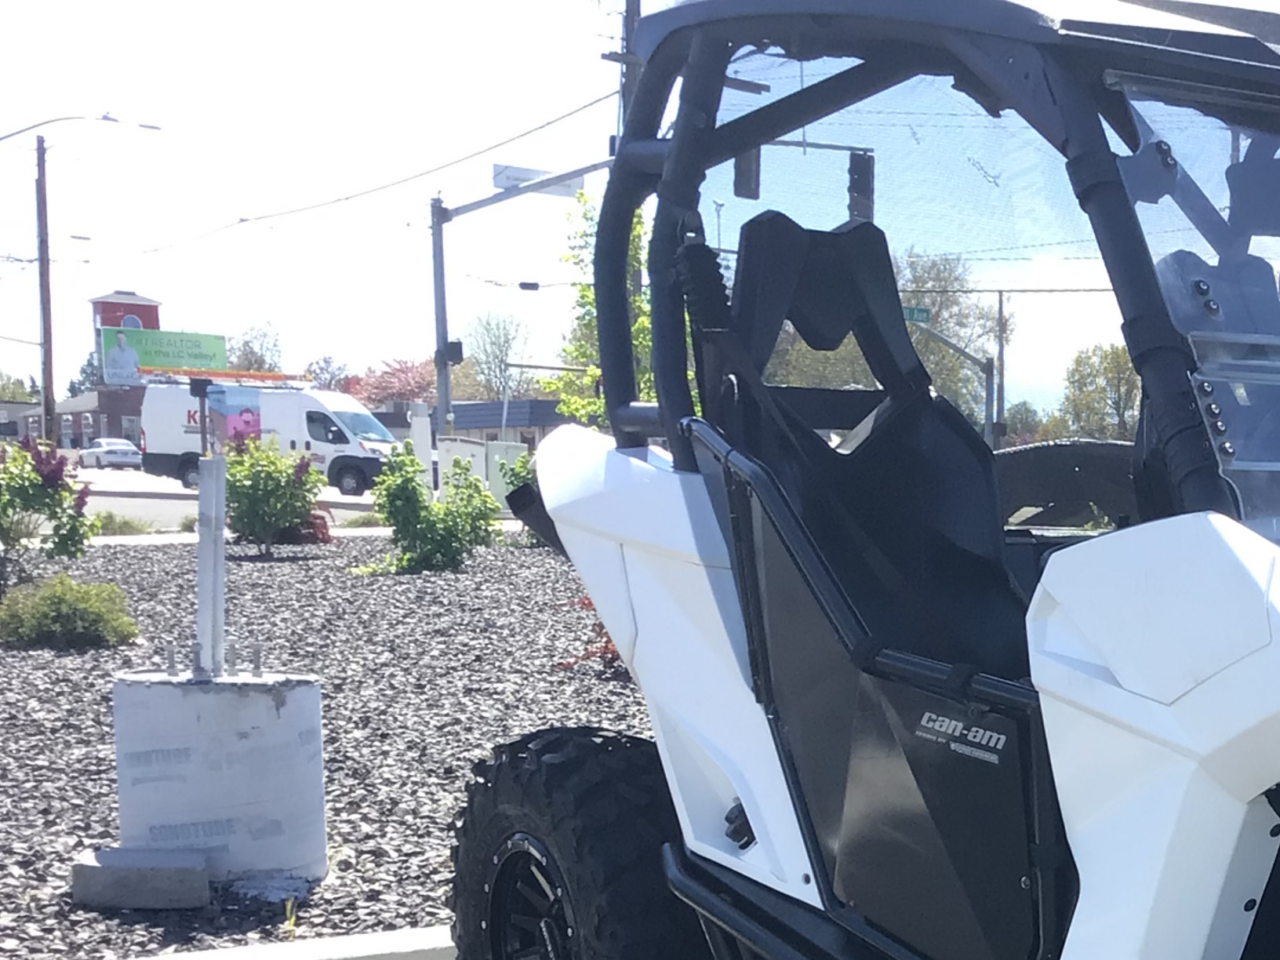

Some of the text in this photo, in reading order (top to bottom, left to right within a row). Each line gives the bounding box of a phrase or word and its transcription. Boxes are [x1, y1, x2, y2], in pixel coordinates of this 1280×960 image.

[151, 338, 202, 350] REALTOR
[154, 349, 171, 358] the
[172, 350, 185, 359] LC
[920, 711, 1007, 750] can-am
[149, 818, 237, 843] SONOTUBE
